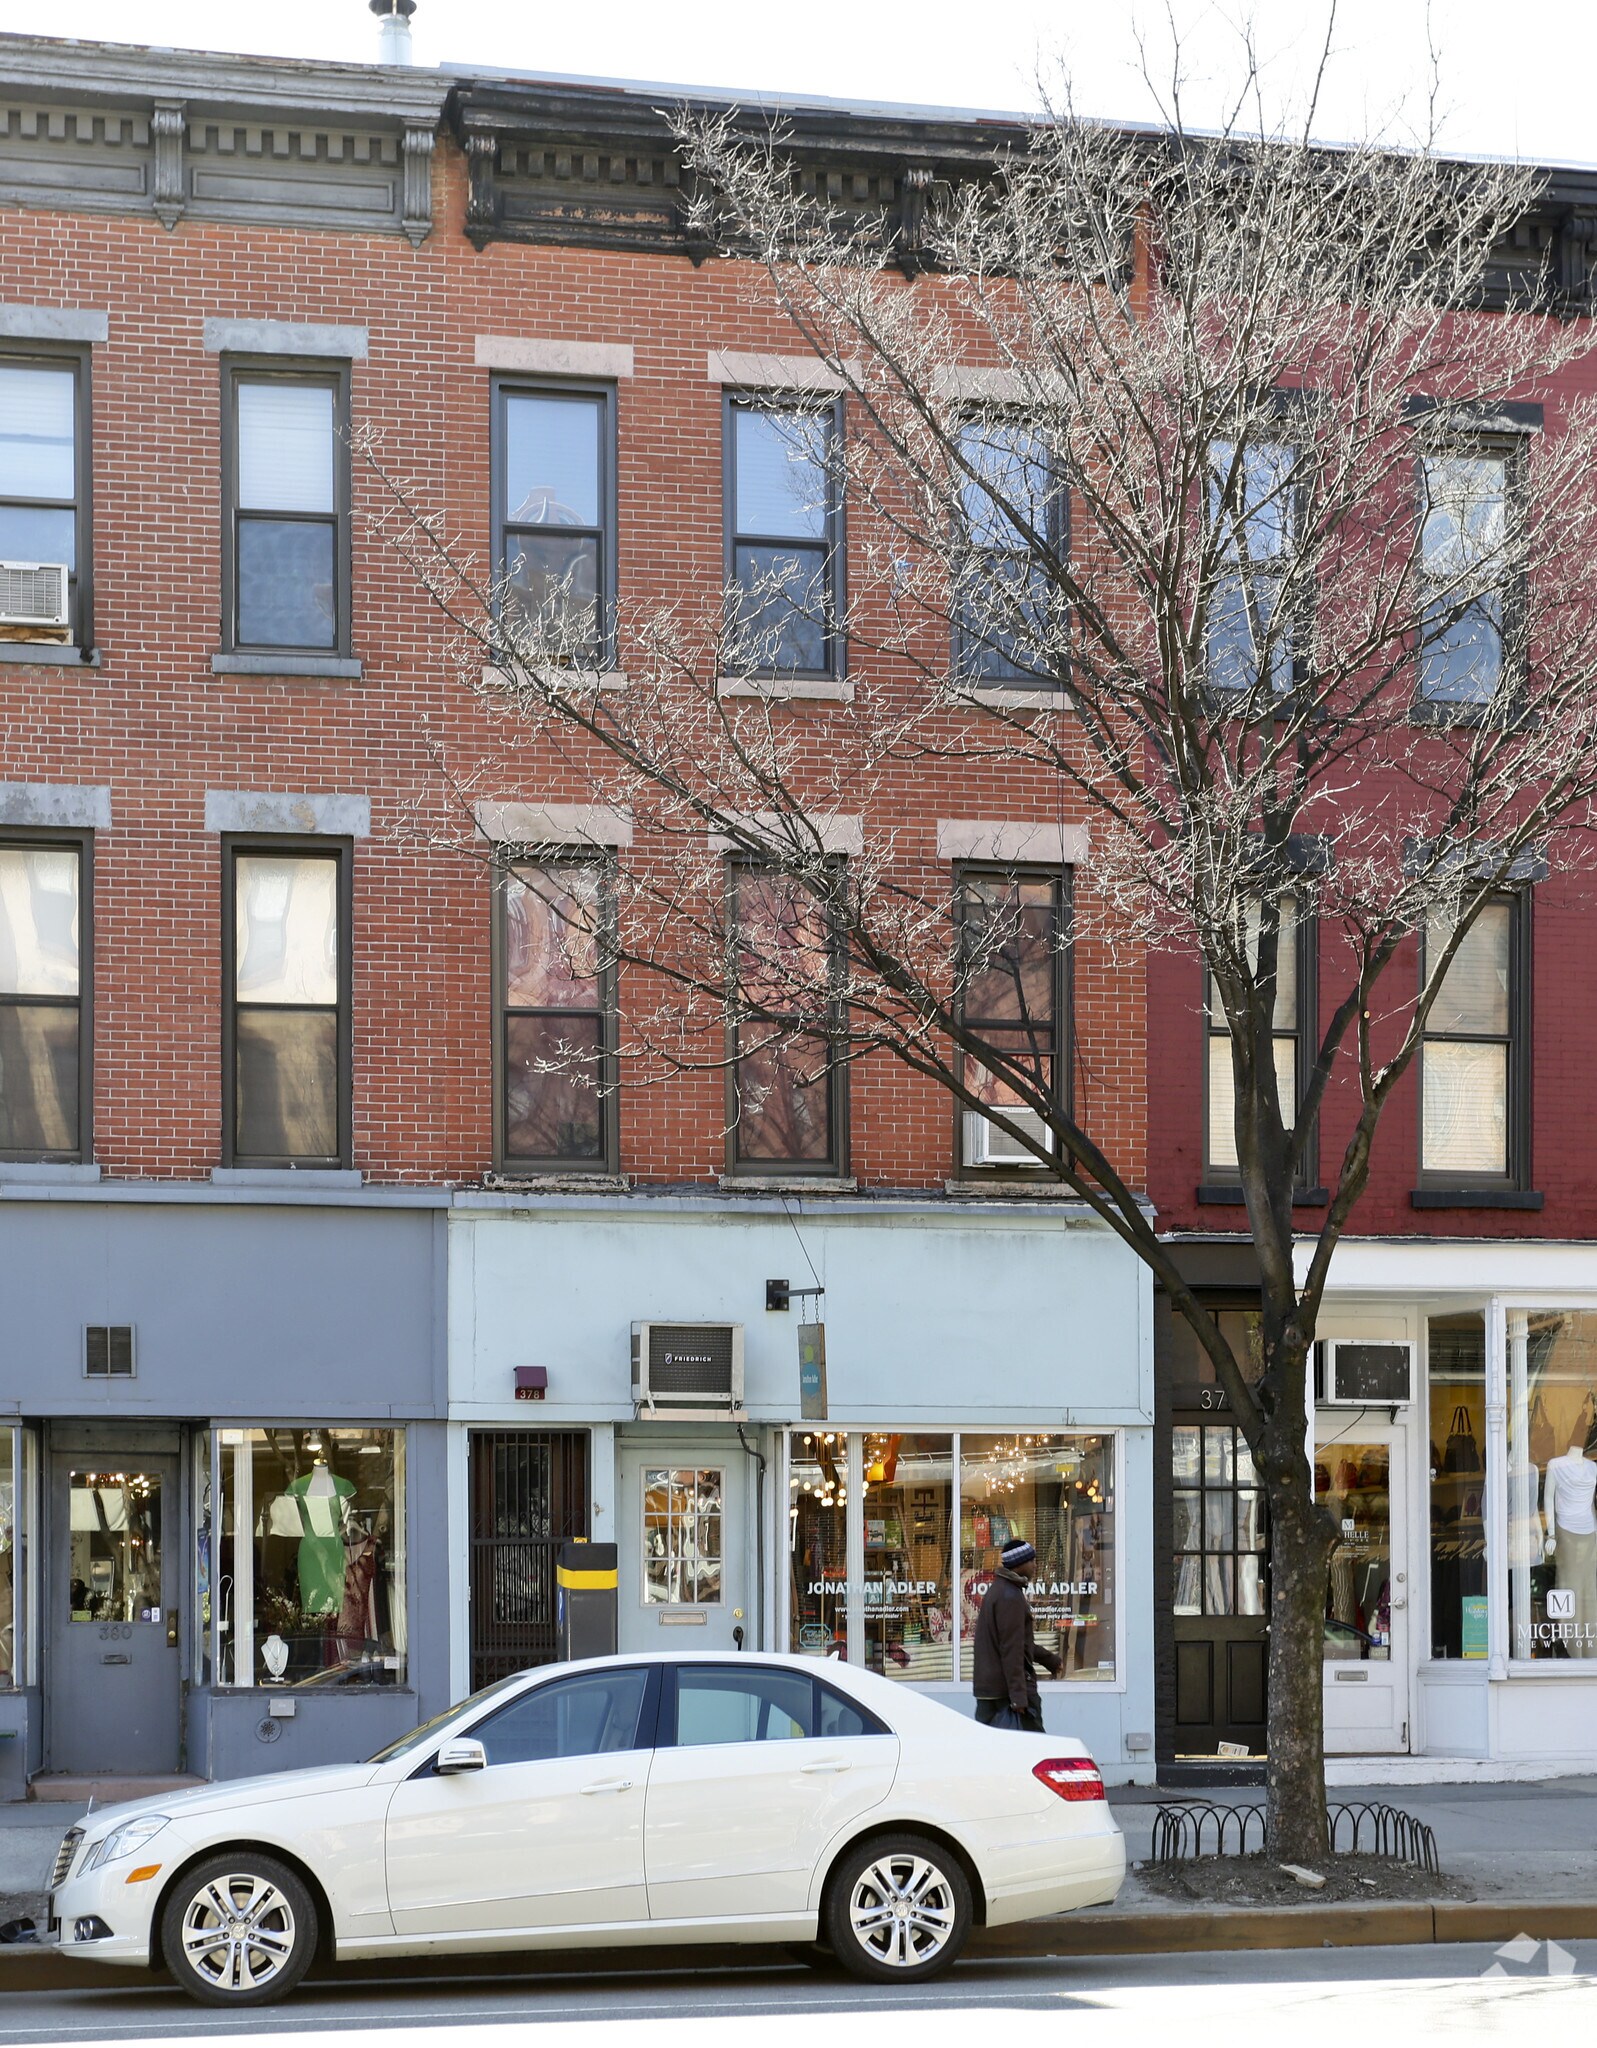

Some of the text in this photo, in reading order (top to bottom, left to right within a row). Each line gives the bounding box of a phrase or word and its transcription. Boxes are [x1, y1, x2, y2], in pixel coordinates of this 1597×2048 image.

[520, 1389, 540, 1399] 378
[1201, 1390, 1225, 1410] 37
[807, 1581, 936, 1594] JONATHAN ADLER
[1049, 1582, 1098, 1595] ADLER
[1517, 1623, 1597, 1639] MICHELL
[1517, 1640, 1594, 1648] NEW YOR
